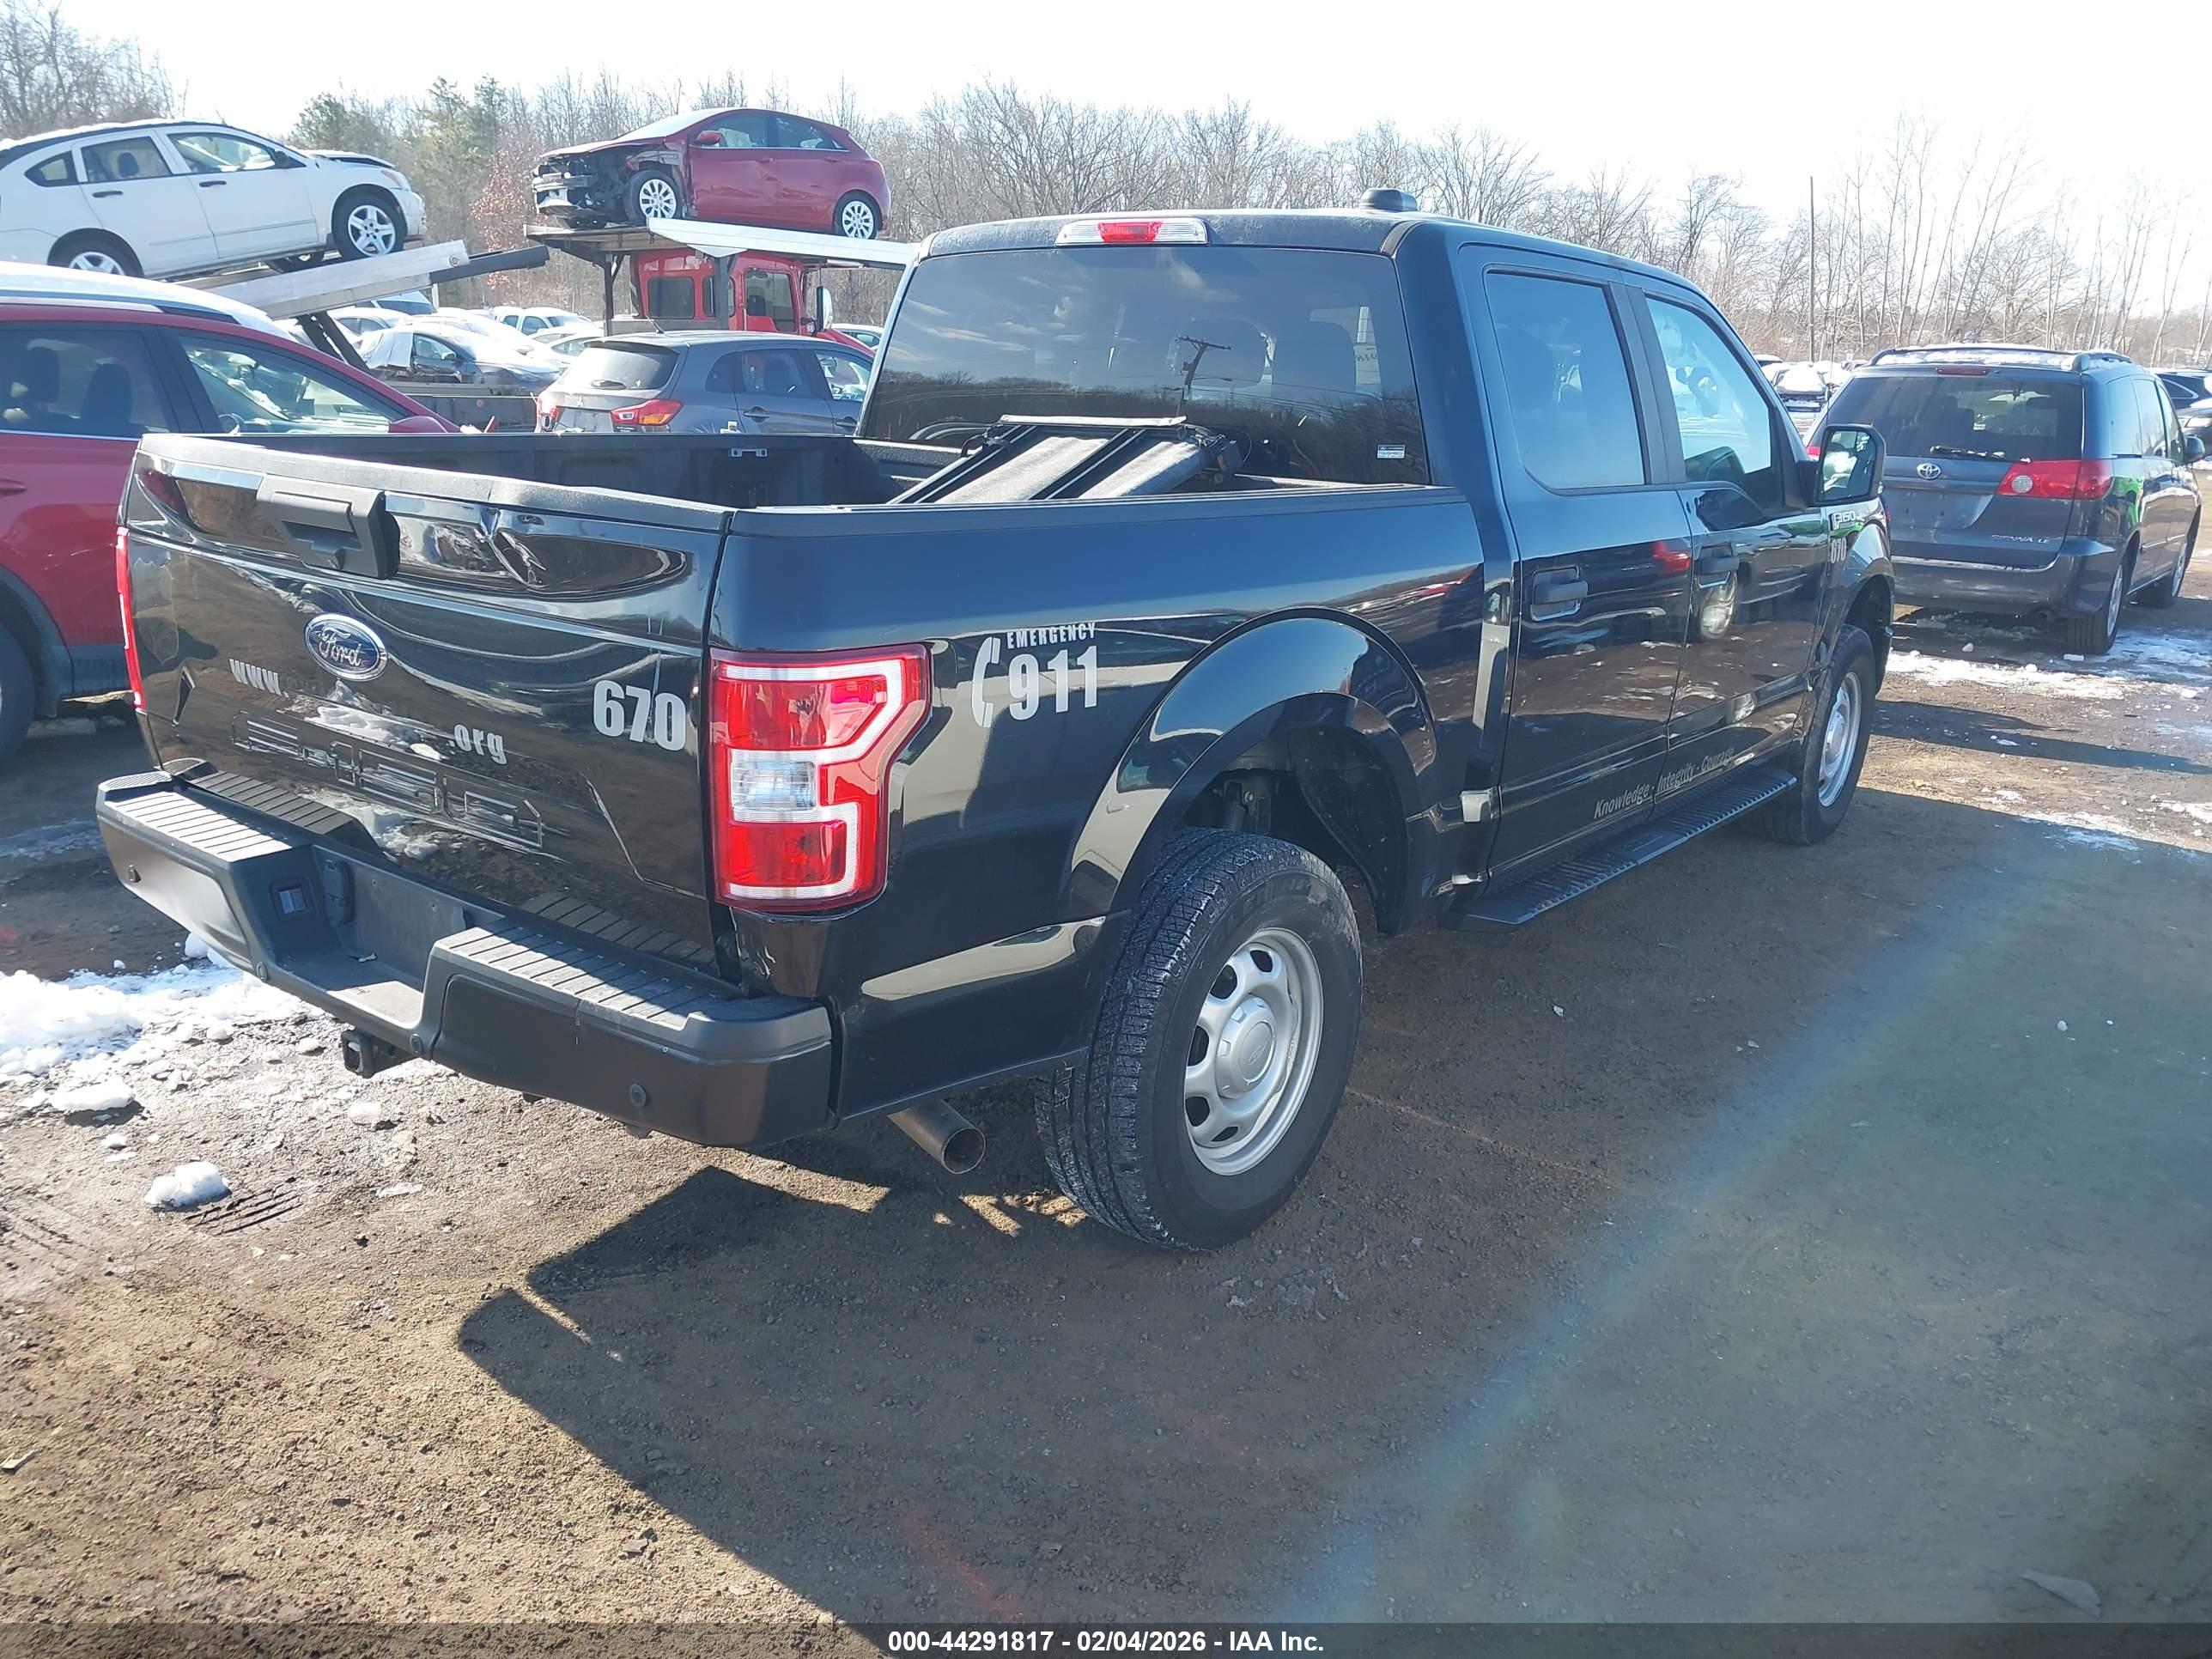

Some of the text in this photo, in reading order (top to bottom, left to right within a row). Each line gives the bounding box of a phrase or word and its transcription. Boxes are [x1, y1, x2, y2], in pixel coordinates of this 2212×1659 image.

[313, 626, 362, 666] Ford
[1006, 622, 1096, 650] EMERGENCY
[1008, 645, 1097, 721] 911
[593, 680, 686, 751] 670
[449, 724, 507, 764] .org
[1594, 782, 1650, 819] Knowledge
[1657, 763, 1696, 793] Integrity
[1701, 745, 1734, 772] Courage
